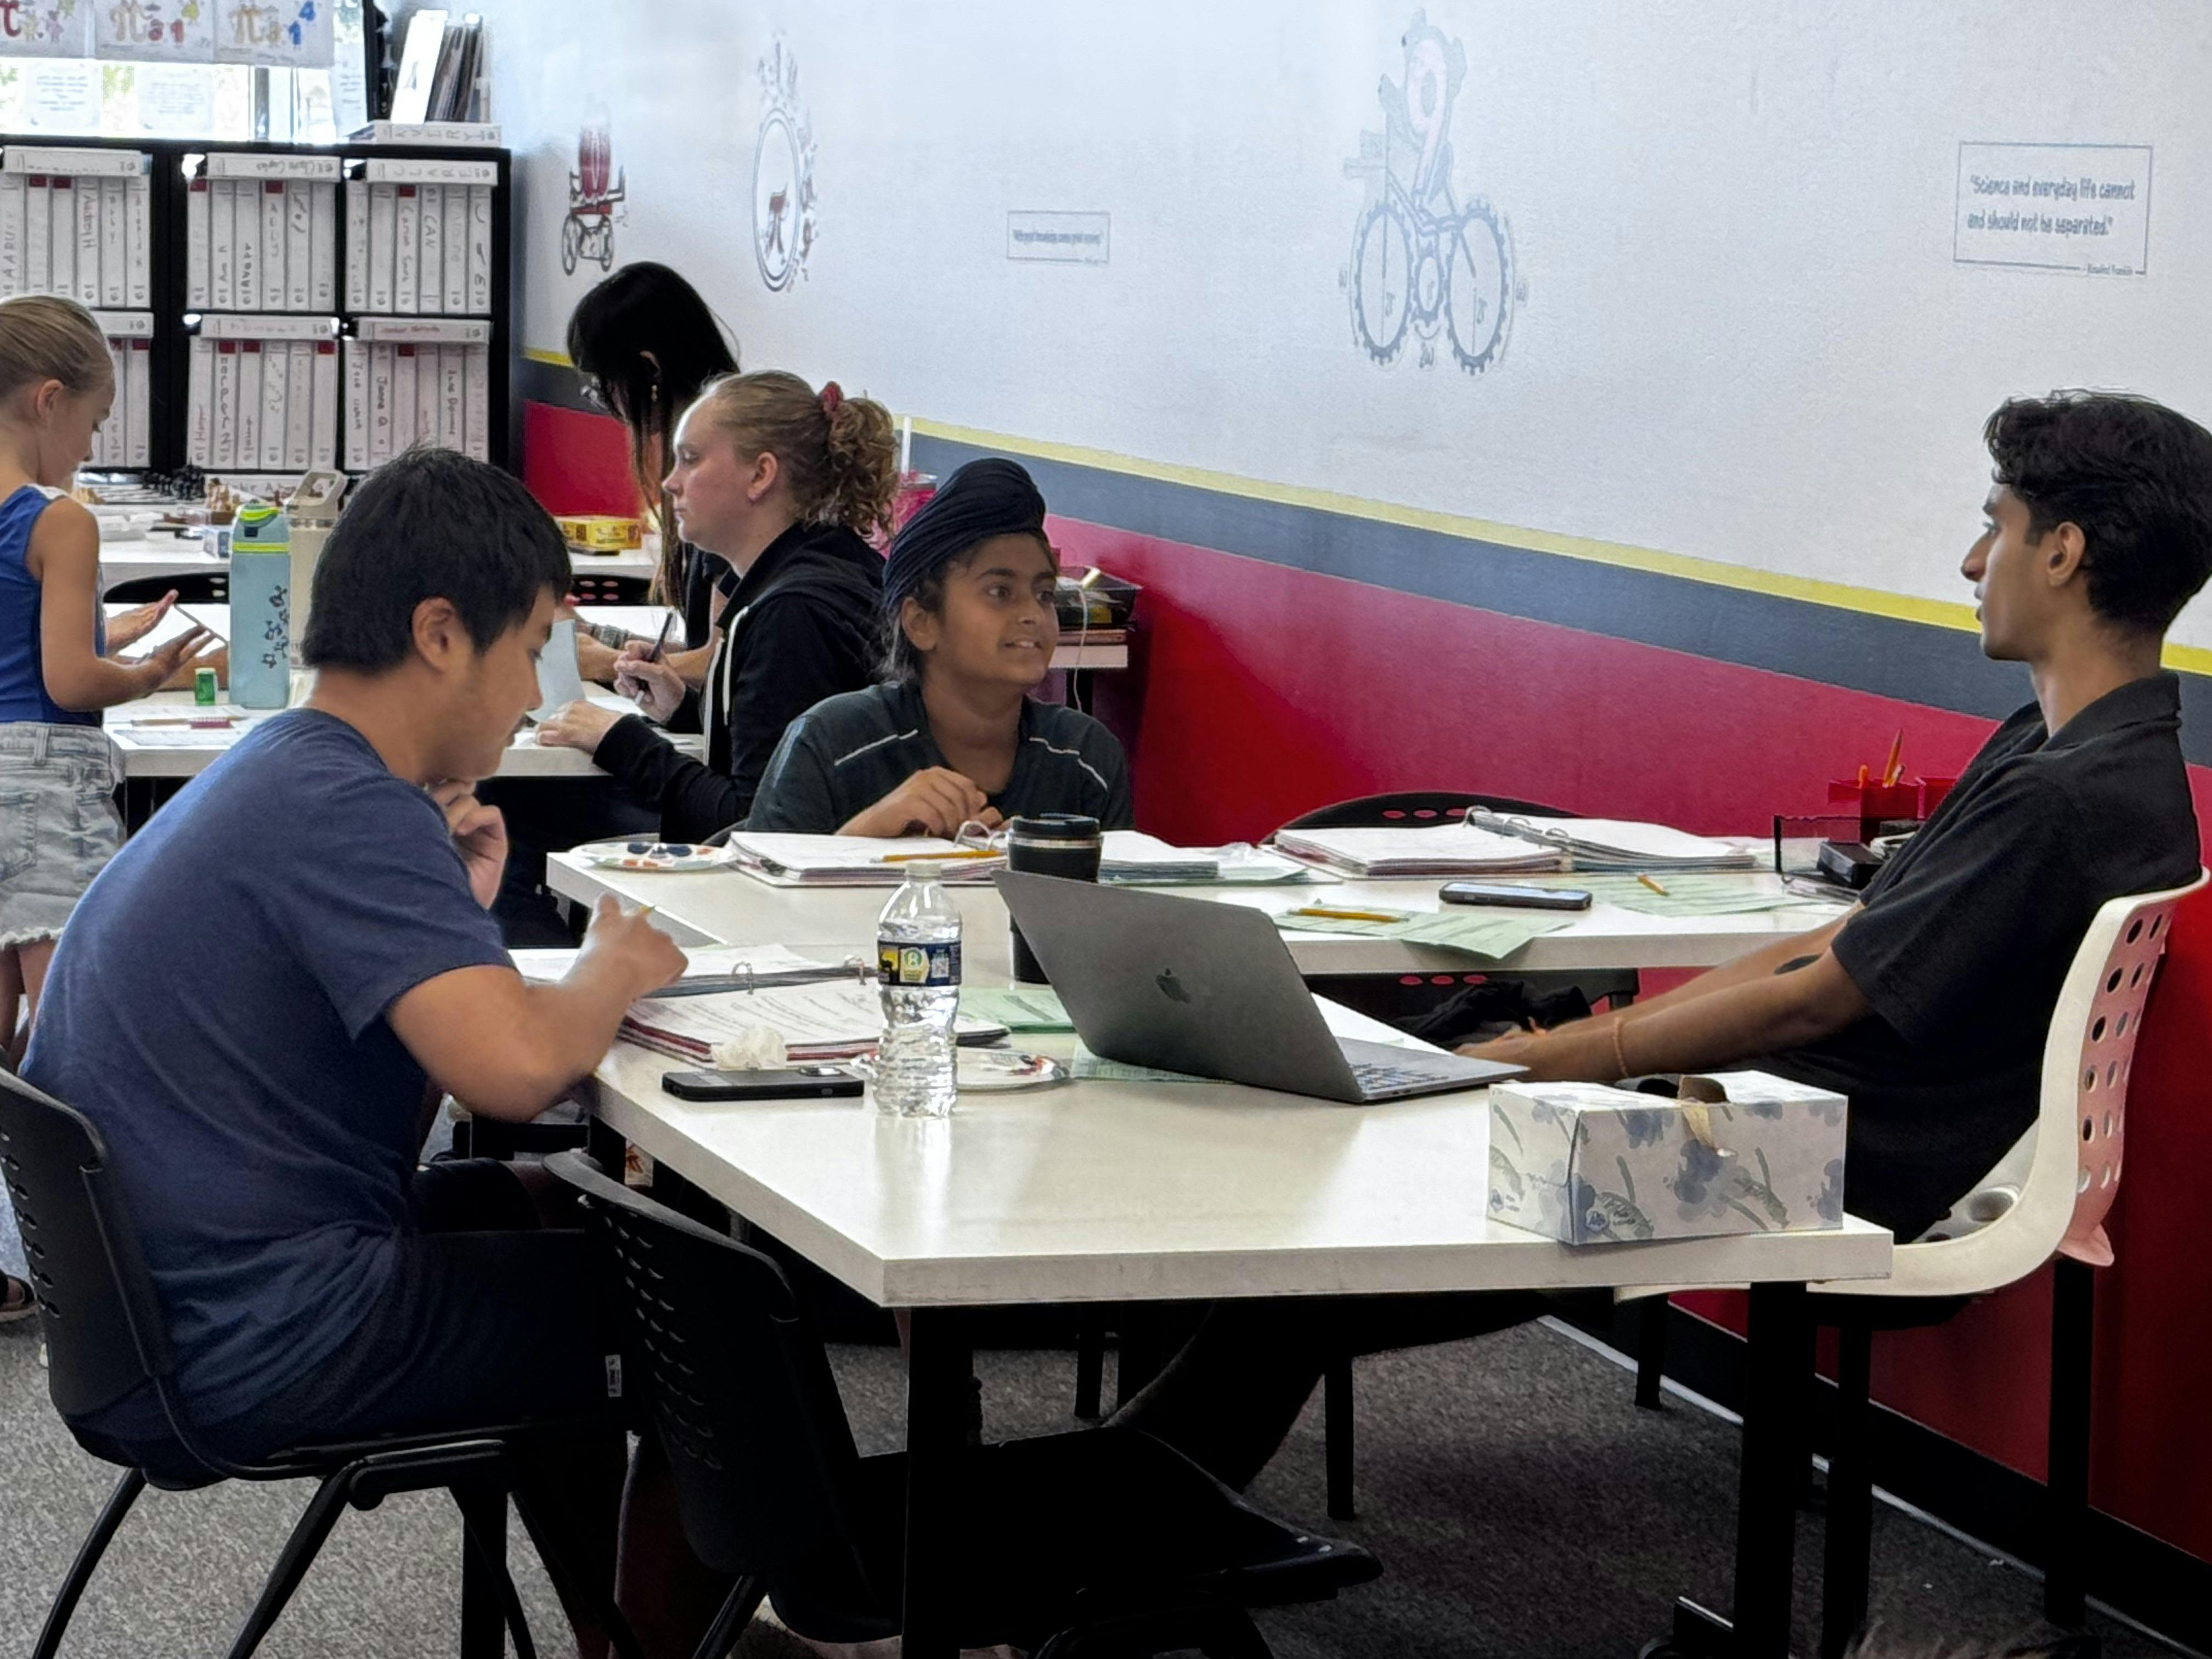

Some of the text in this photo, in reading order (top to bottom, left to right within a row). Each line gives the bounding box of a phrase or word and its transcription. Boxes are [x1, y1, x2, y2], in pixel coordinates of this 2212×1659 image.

[2012, 174, 2031, 196] and
[2033, 177, 2078, 201] everyday
[2080, 177, 2097, 199] life
[2099, 179, 2136, 200] cannot
[1967, 208, 1985, 229] and
[1987, 209, 2020, 231] should
[2021, 212, 2039, 233] not
[2040, 213, 2053, 234] be
